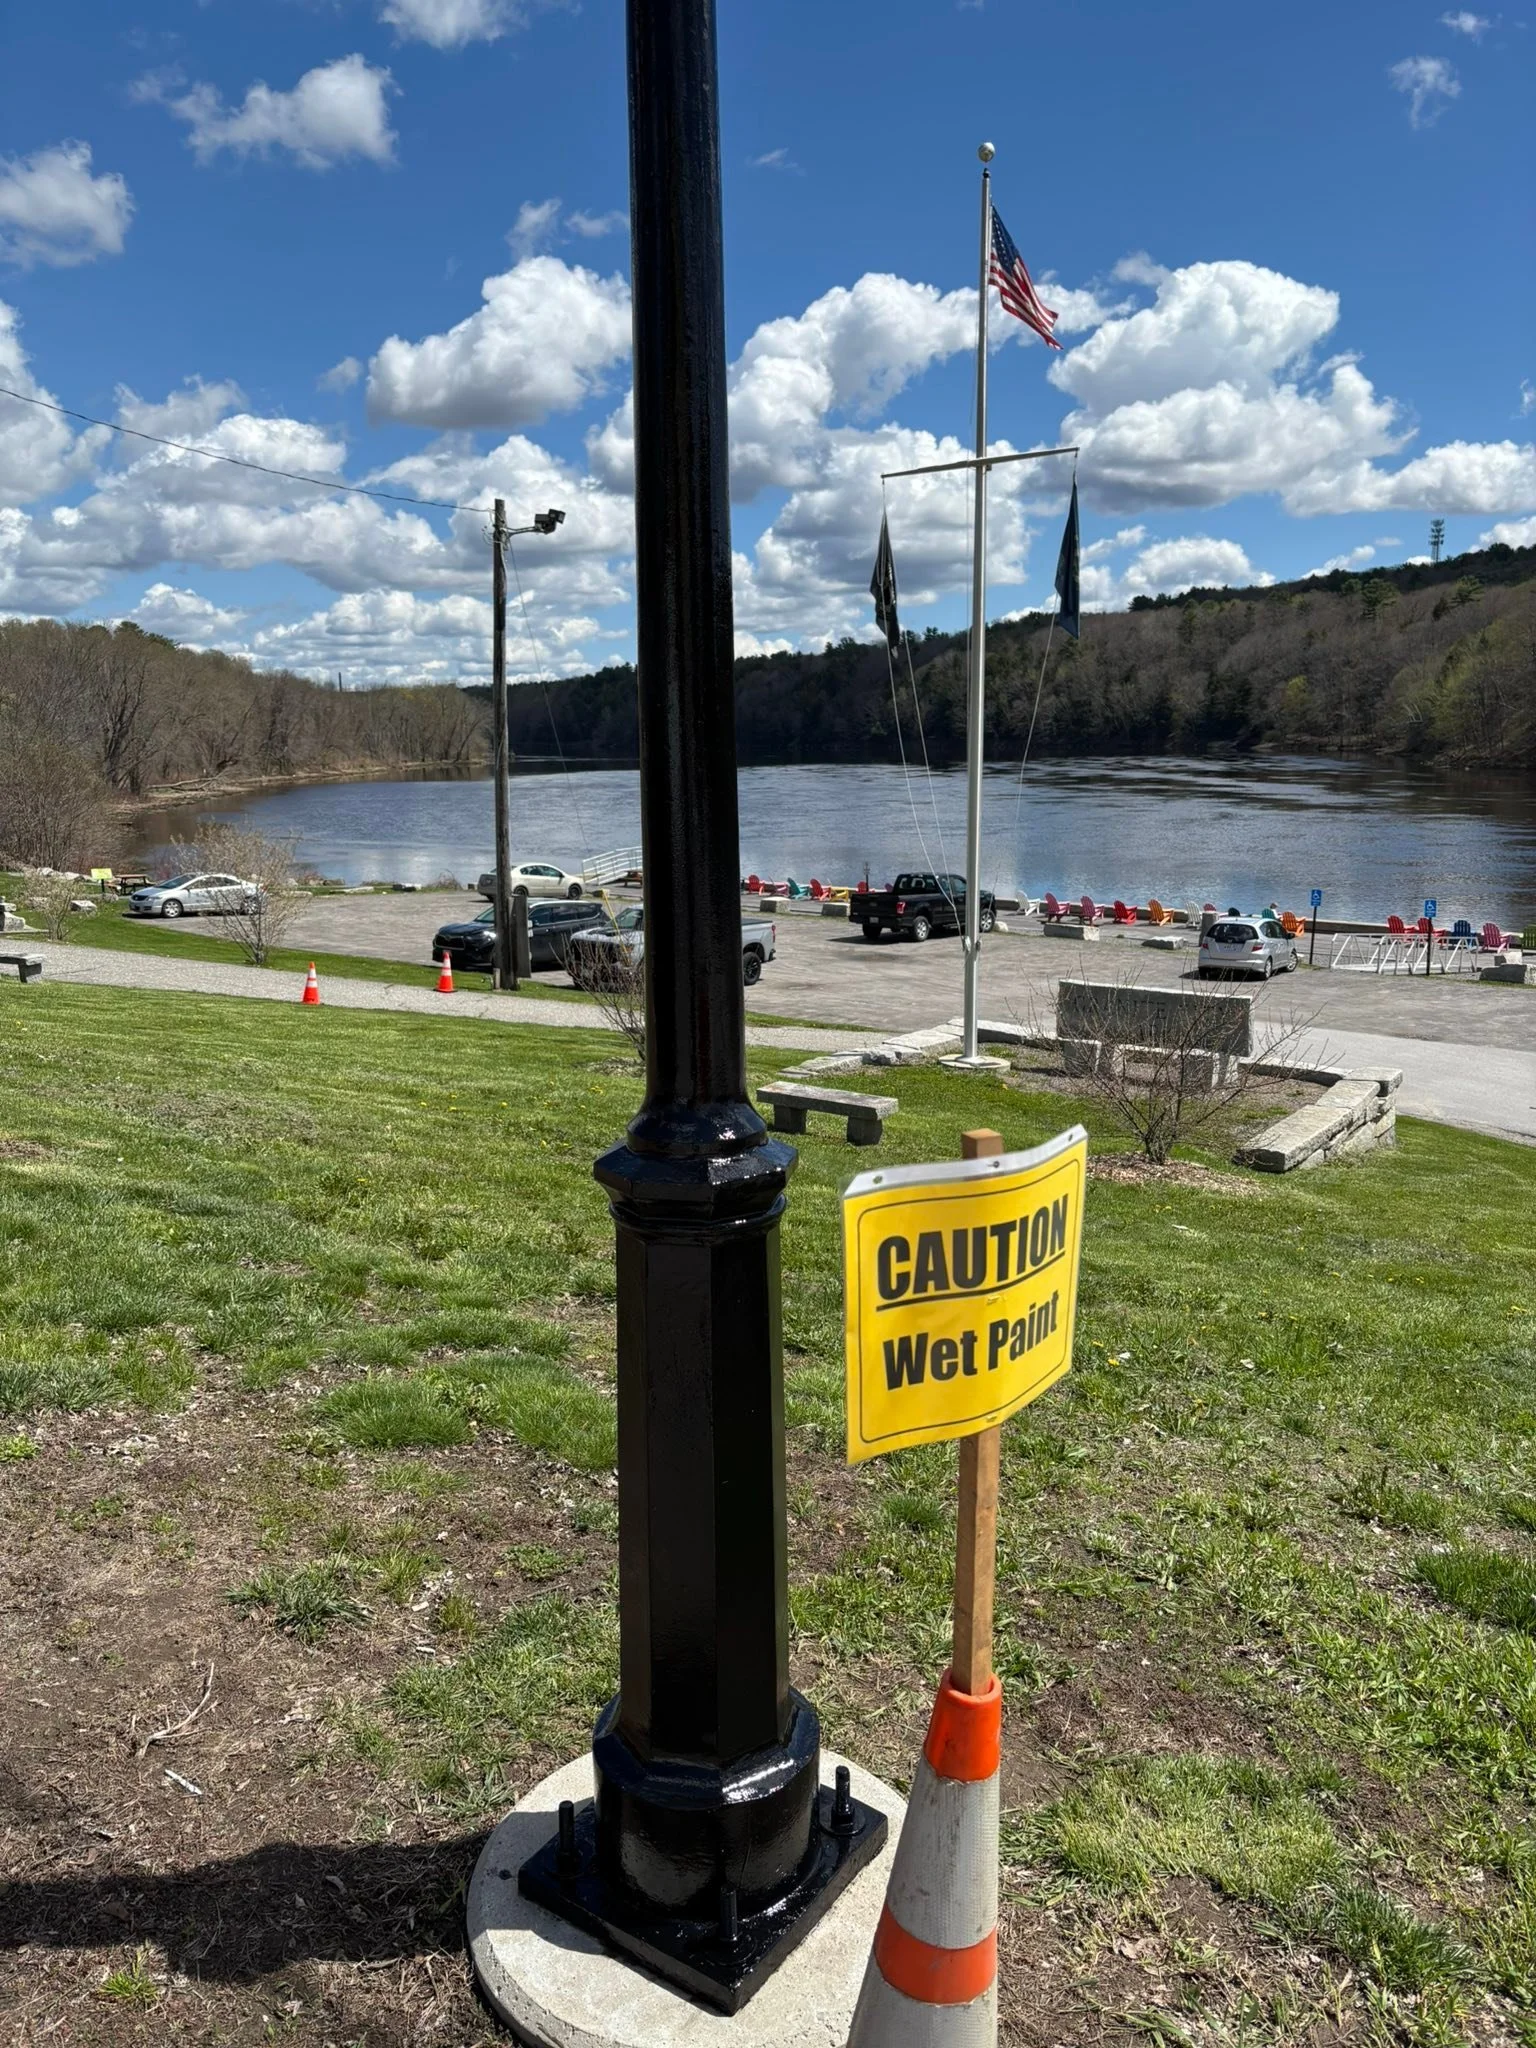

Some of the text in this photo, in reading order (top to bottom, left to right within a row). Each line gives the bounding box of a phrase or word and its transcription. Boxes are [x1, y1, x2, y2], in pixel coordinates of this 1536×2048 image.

[1073, 995, 1167, 1020] GNITE
[877, 1193, 1069, 1301] CAUTION
[882, 1289, 1059, 1391] Wet Paint
